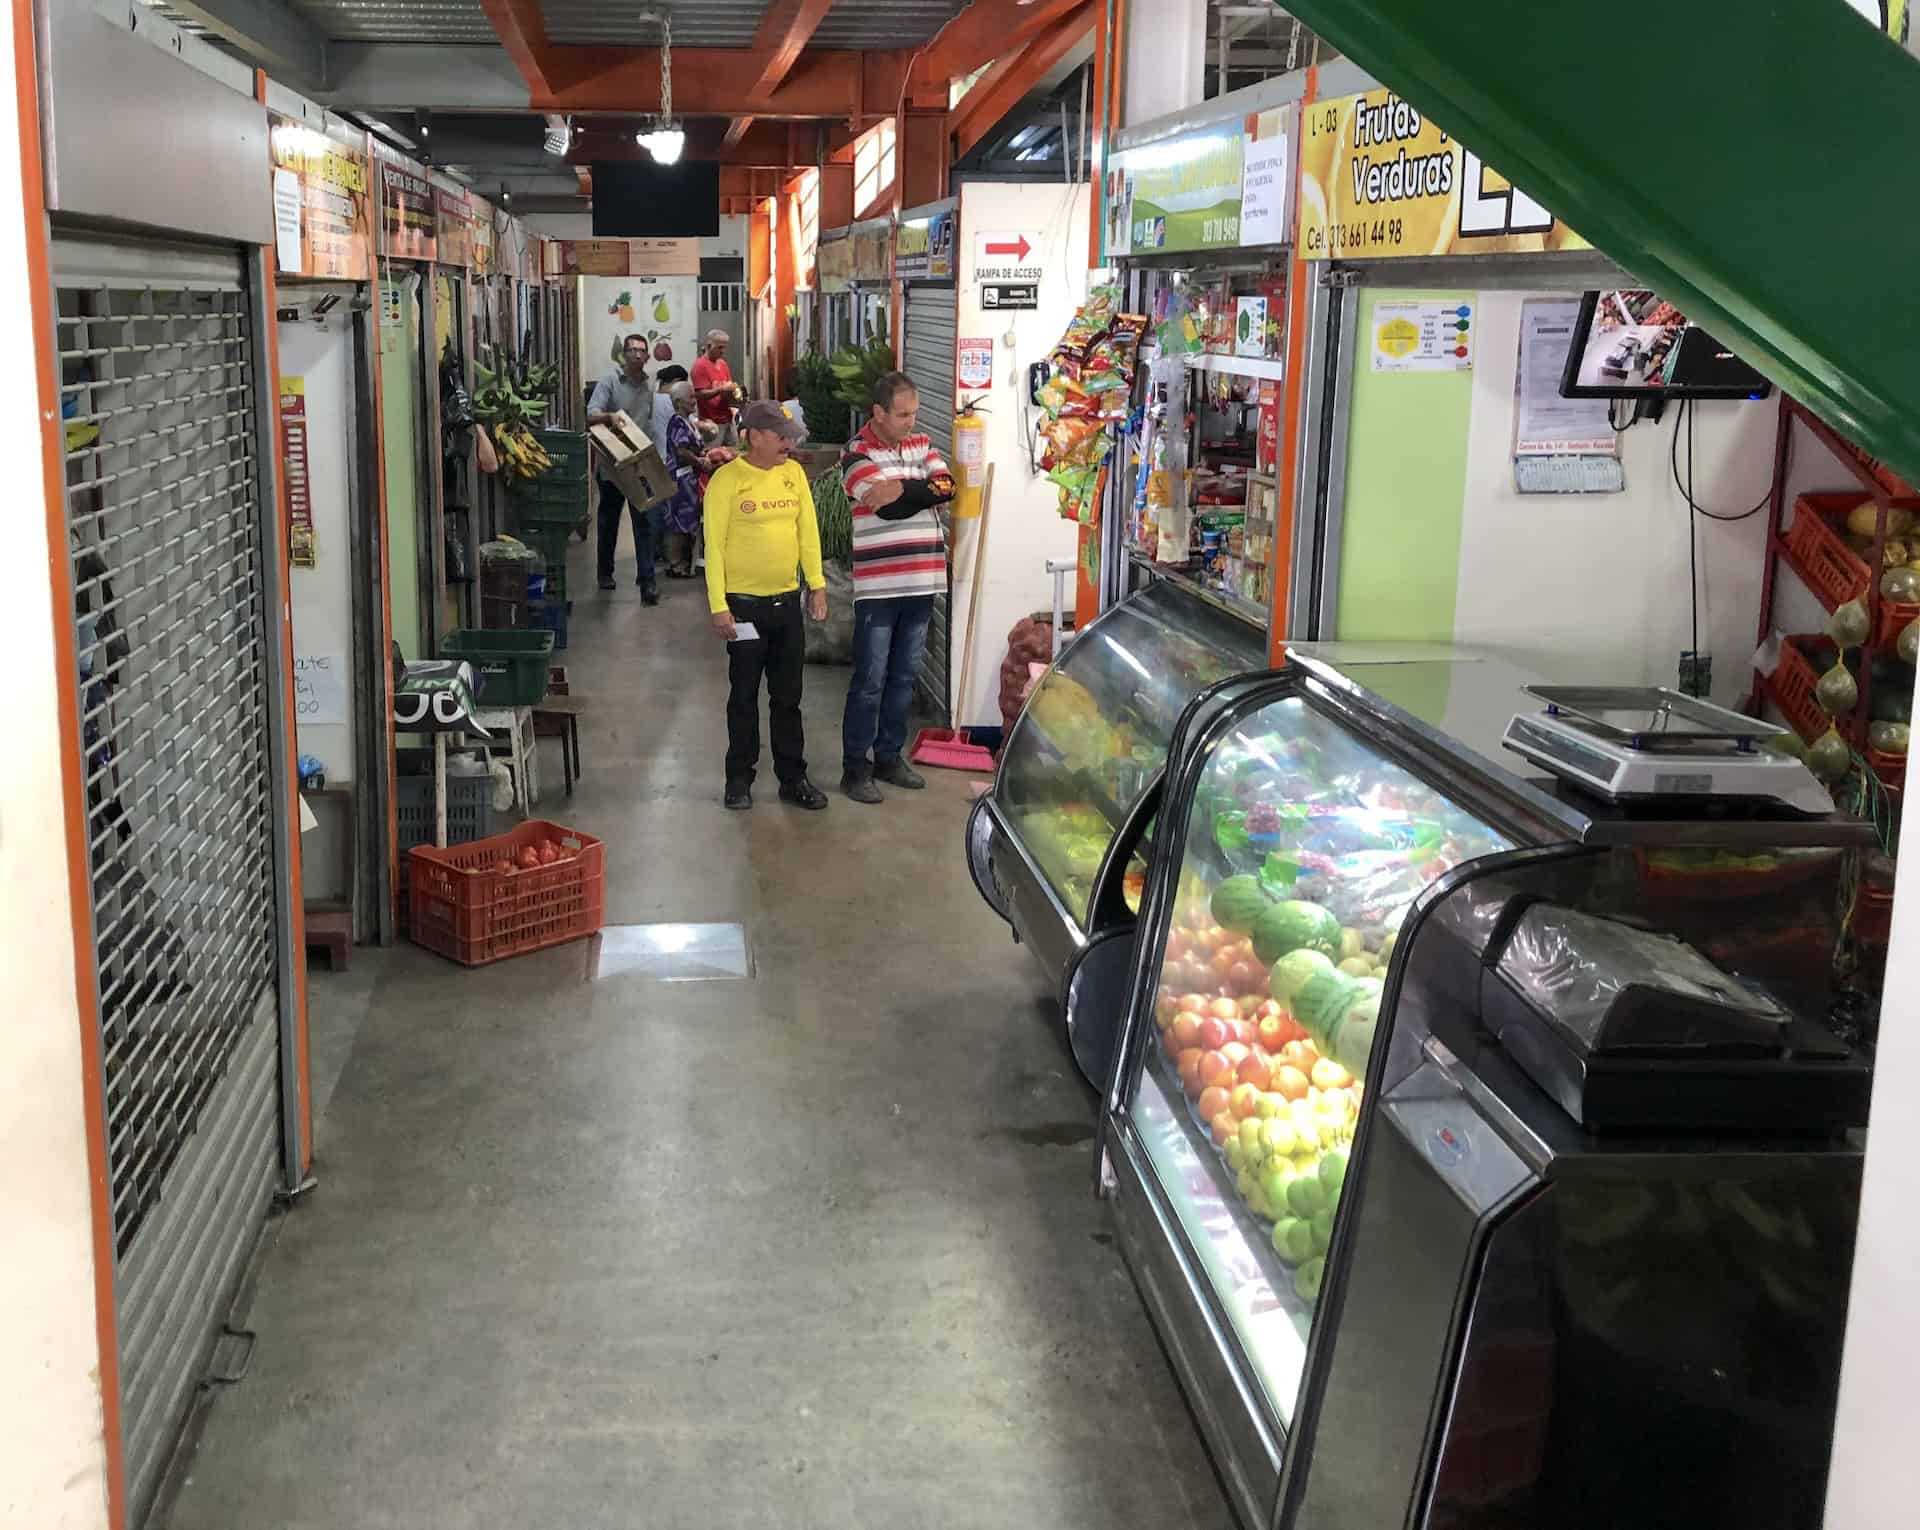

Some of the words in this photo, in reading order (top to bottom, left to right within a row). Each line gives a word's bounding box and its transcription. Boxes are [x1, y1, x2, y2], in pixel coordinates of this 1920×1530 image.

[1325, 108, 1338, 134] 03
[1354, 92, 1422, 148] Frutas
[1353, 147, 1454, 205] Verduras
[1307, 226, 1326, 250] Cel.
[1329, 223, 1346, 248] 313
[1349, 222, 1367, 247] 661
[1371, 220, 1385, 245] 44
[1388, 218, 1402, 246] 98
[976, 267, 1001, 279] RAMPA
[1002, 267, 1012, 279] DE
[1013, 267, 1042, 279] ACCESO
